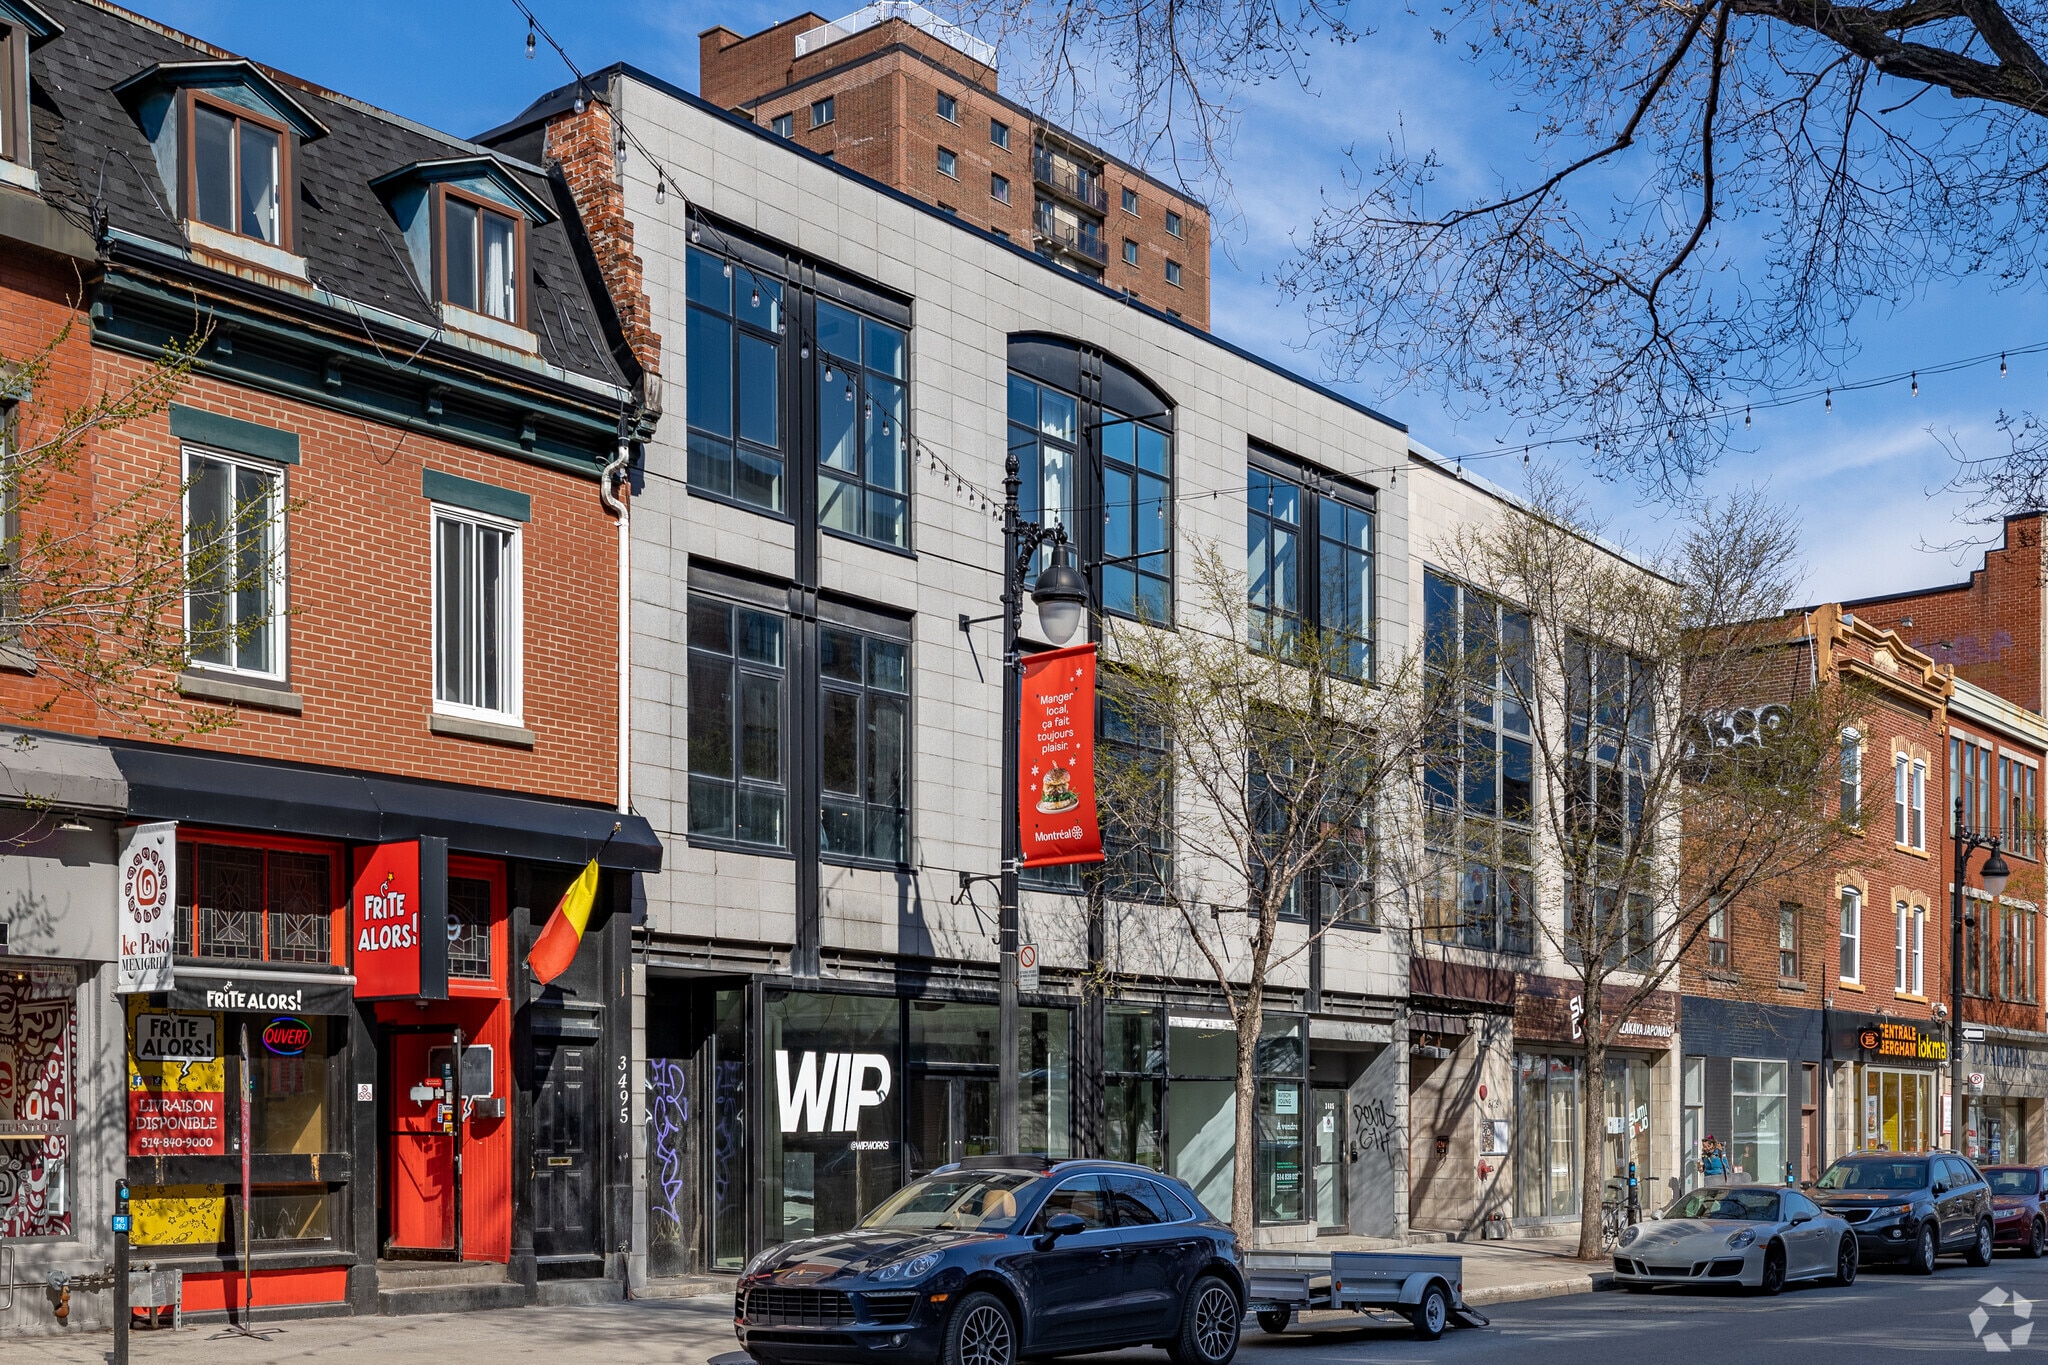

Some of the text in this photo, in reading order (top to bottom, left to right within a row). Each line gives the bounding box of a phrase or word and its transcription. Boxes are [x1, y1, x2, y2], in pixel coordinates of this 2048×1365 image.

[1040, 692, 1074, 704] Manger
[1046, 703, 1069, 716] local,
[1041, 716, 1070, 731] ça fait
[1037, 729, 1074, 742] toujours
[1041, 741, 1069, 756] plaisir.
[1034, 828, 1072, 842] Montréal
[364, 891, 406, 920] FRITE
[357, 911, 418, 952] ALORS!
[121, 931, 170, 956] ke Pasó
[121, 956, 170, 972] MEXIGRILL
[206, 989, 302, 1011] FRITE ALORS!
[150, 1018, 198, 1038] FRITE
[265, 1028, 309, 1045] OUVERT
[1643, 1024, 1672, 1037] JAPONAIS
[1879, 1023, 1917, 1041] CENTRALE
[141, 1033, 212, 1056] ALORS!
[1879, 1040, 1917, 1057] BERGHAM
[1917, 1033, 1947, 1059] lokma
[617, 1055, 629, 1124] 3495
[775, 1050, 891, 1133] WIP
[139, 1099, 213, 1113] LIVRAISON
[136, 1116, 218, 1131] DISPONIBLE
[141, 1137, 214, 1149] 514-840-9000
